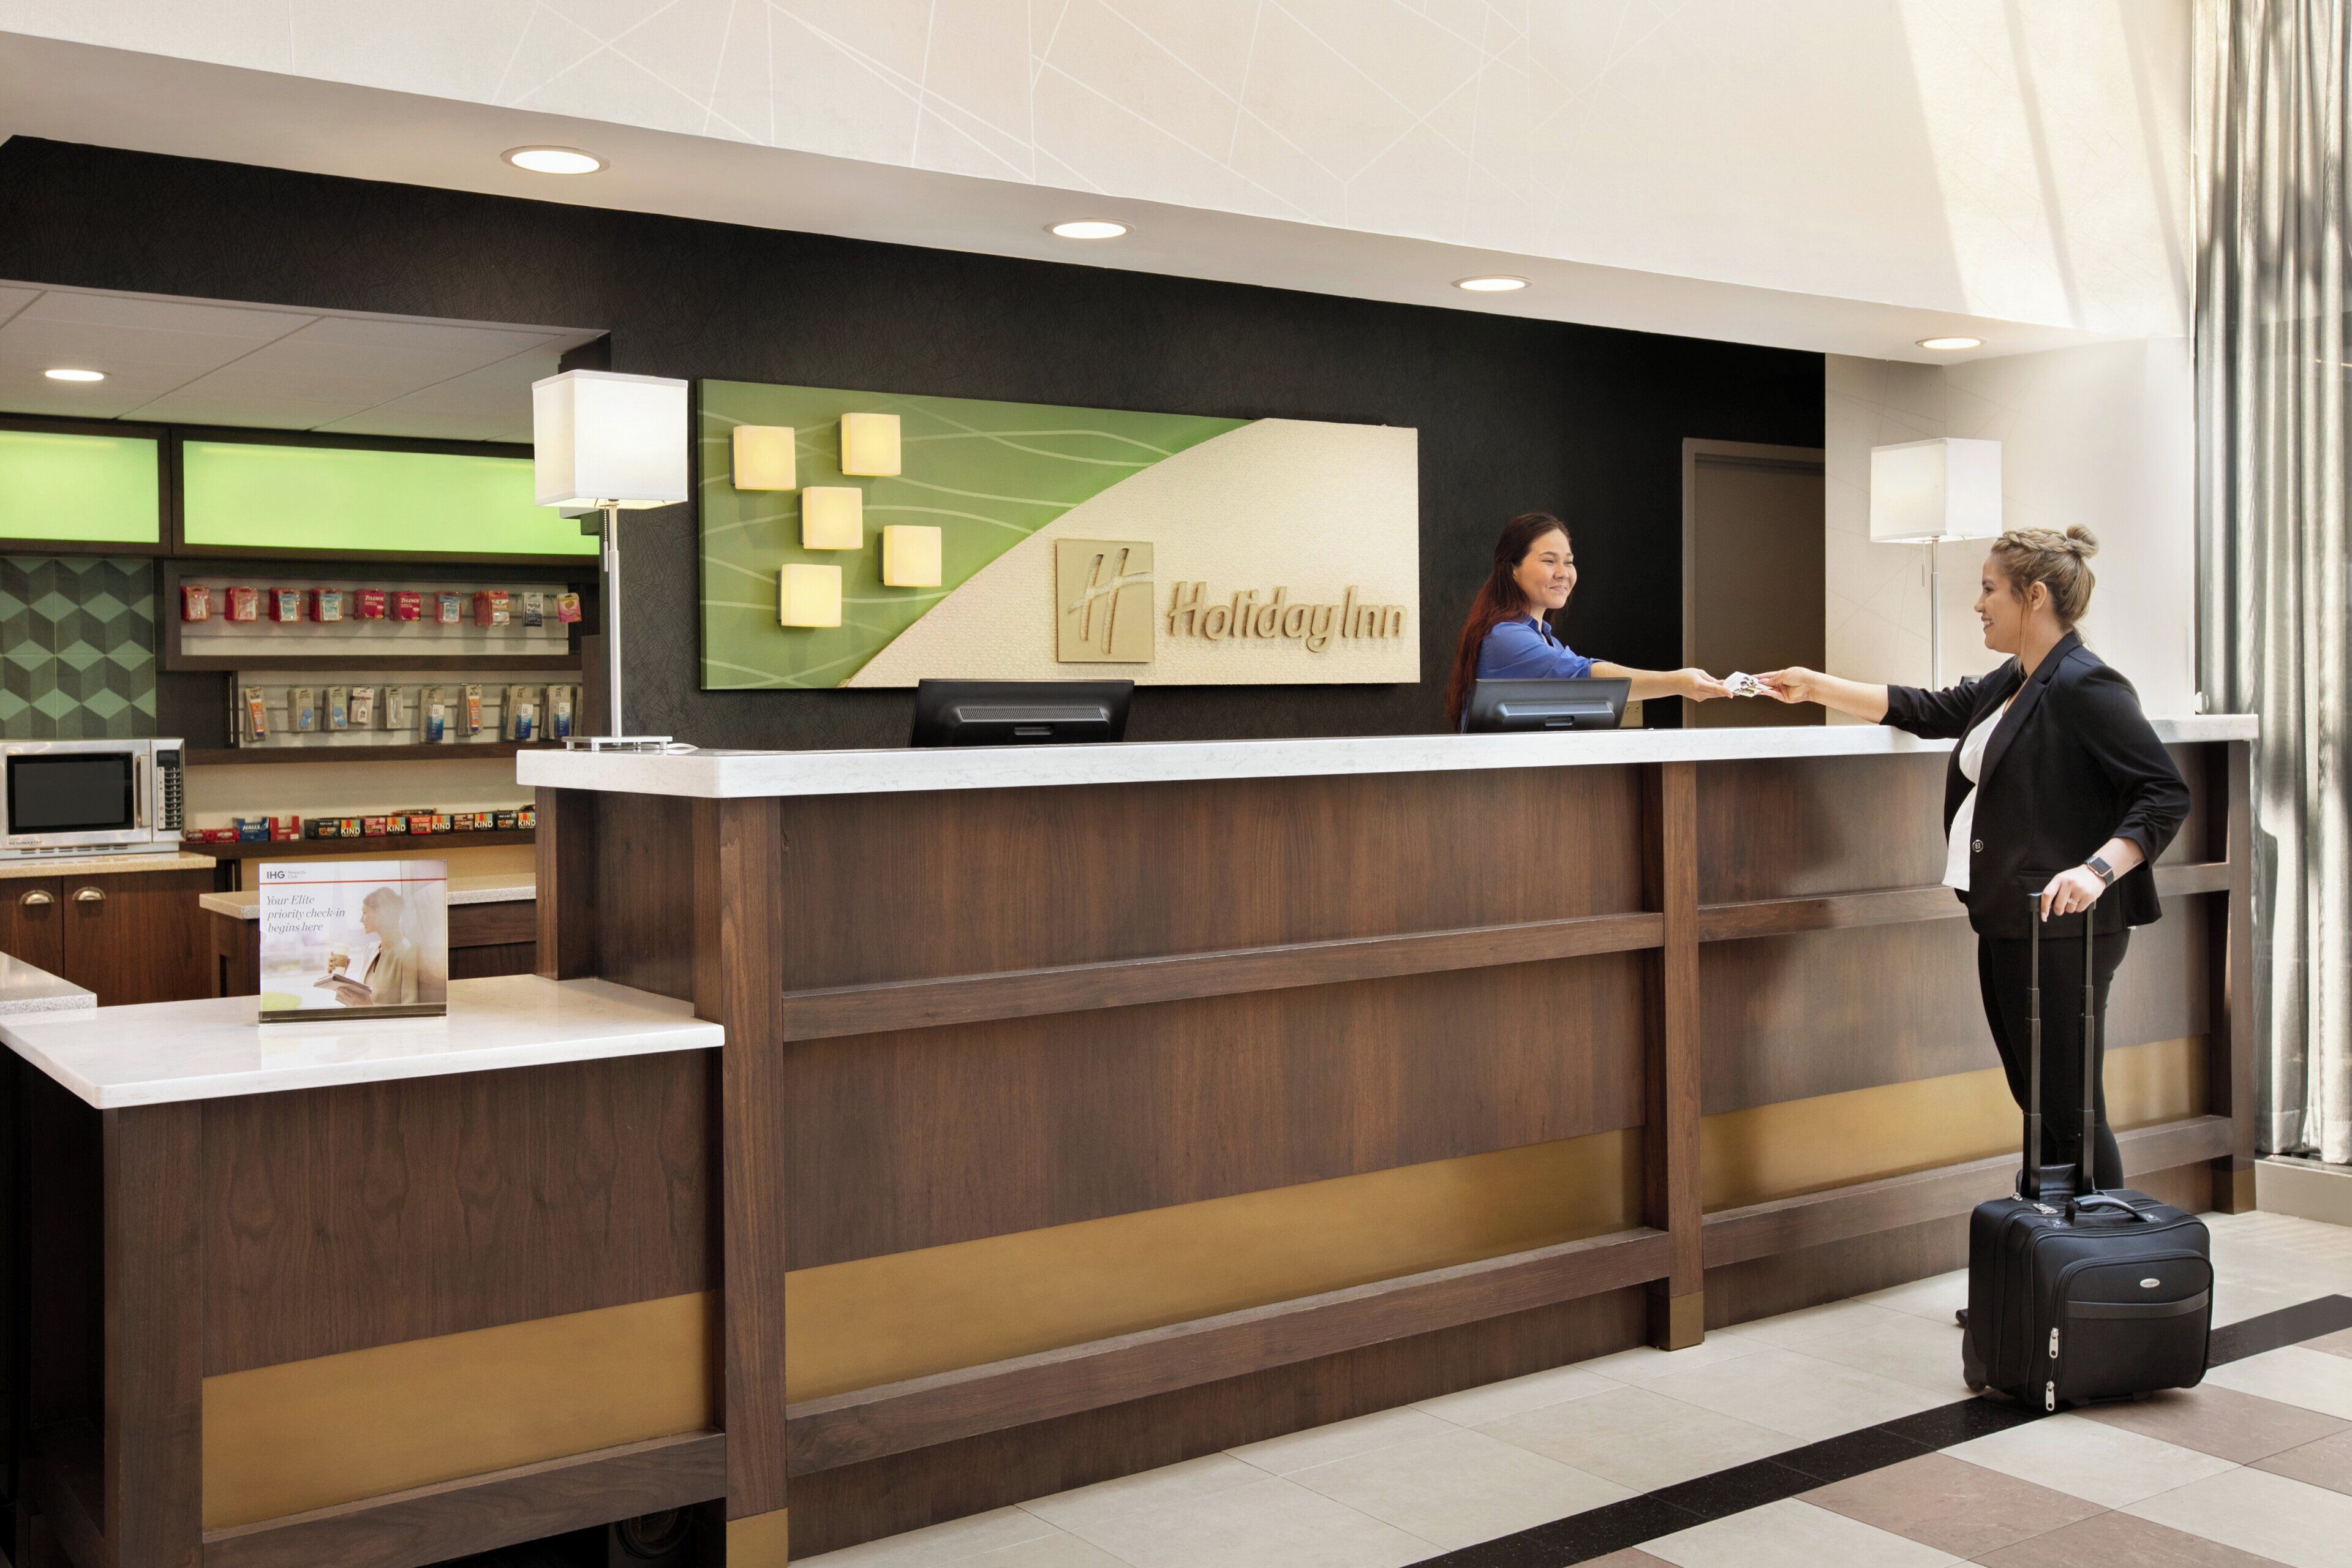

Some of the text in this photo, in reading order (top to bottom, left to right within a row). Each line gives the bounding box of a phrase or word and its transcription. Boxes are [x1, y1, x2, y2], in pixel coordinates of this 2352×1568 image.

[1169, 581, 1407, 653] Holiday Inn
[266, 895, 314, 905] Your Elite
[267, 908, 345, 921] priority check-in
[268, 922, 323, 934] begins here
